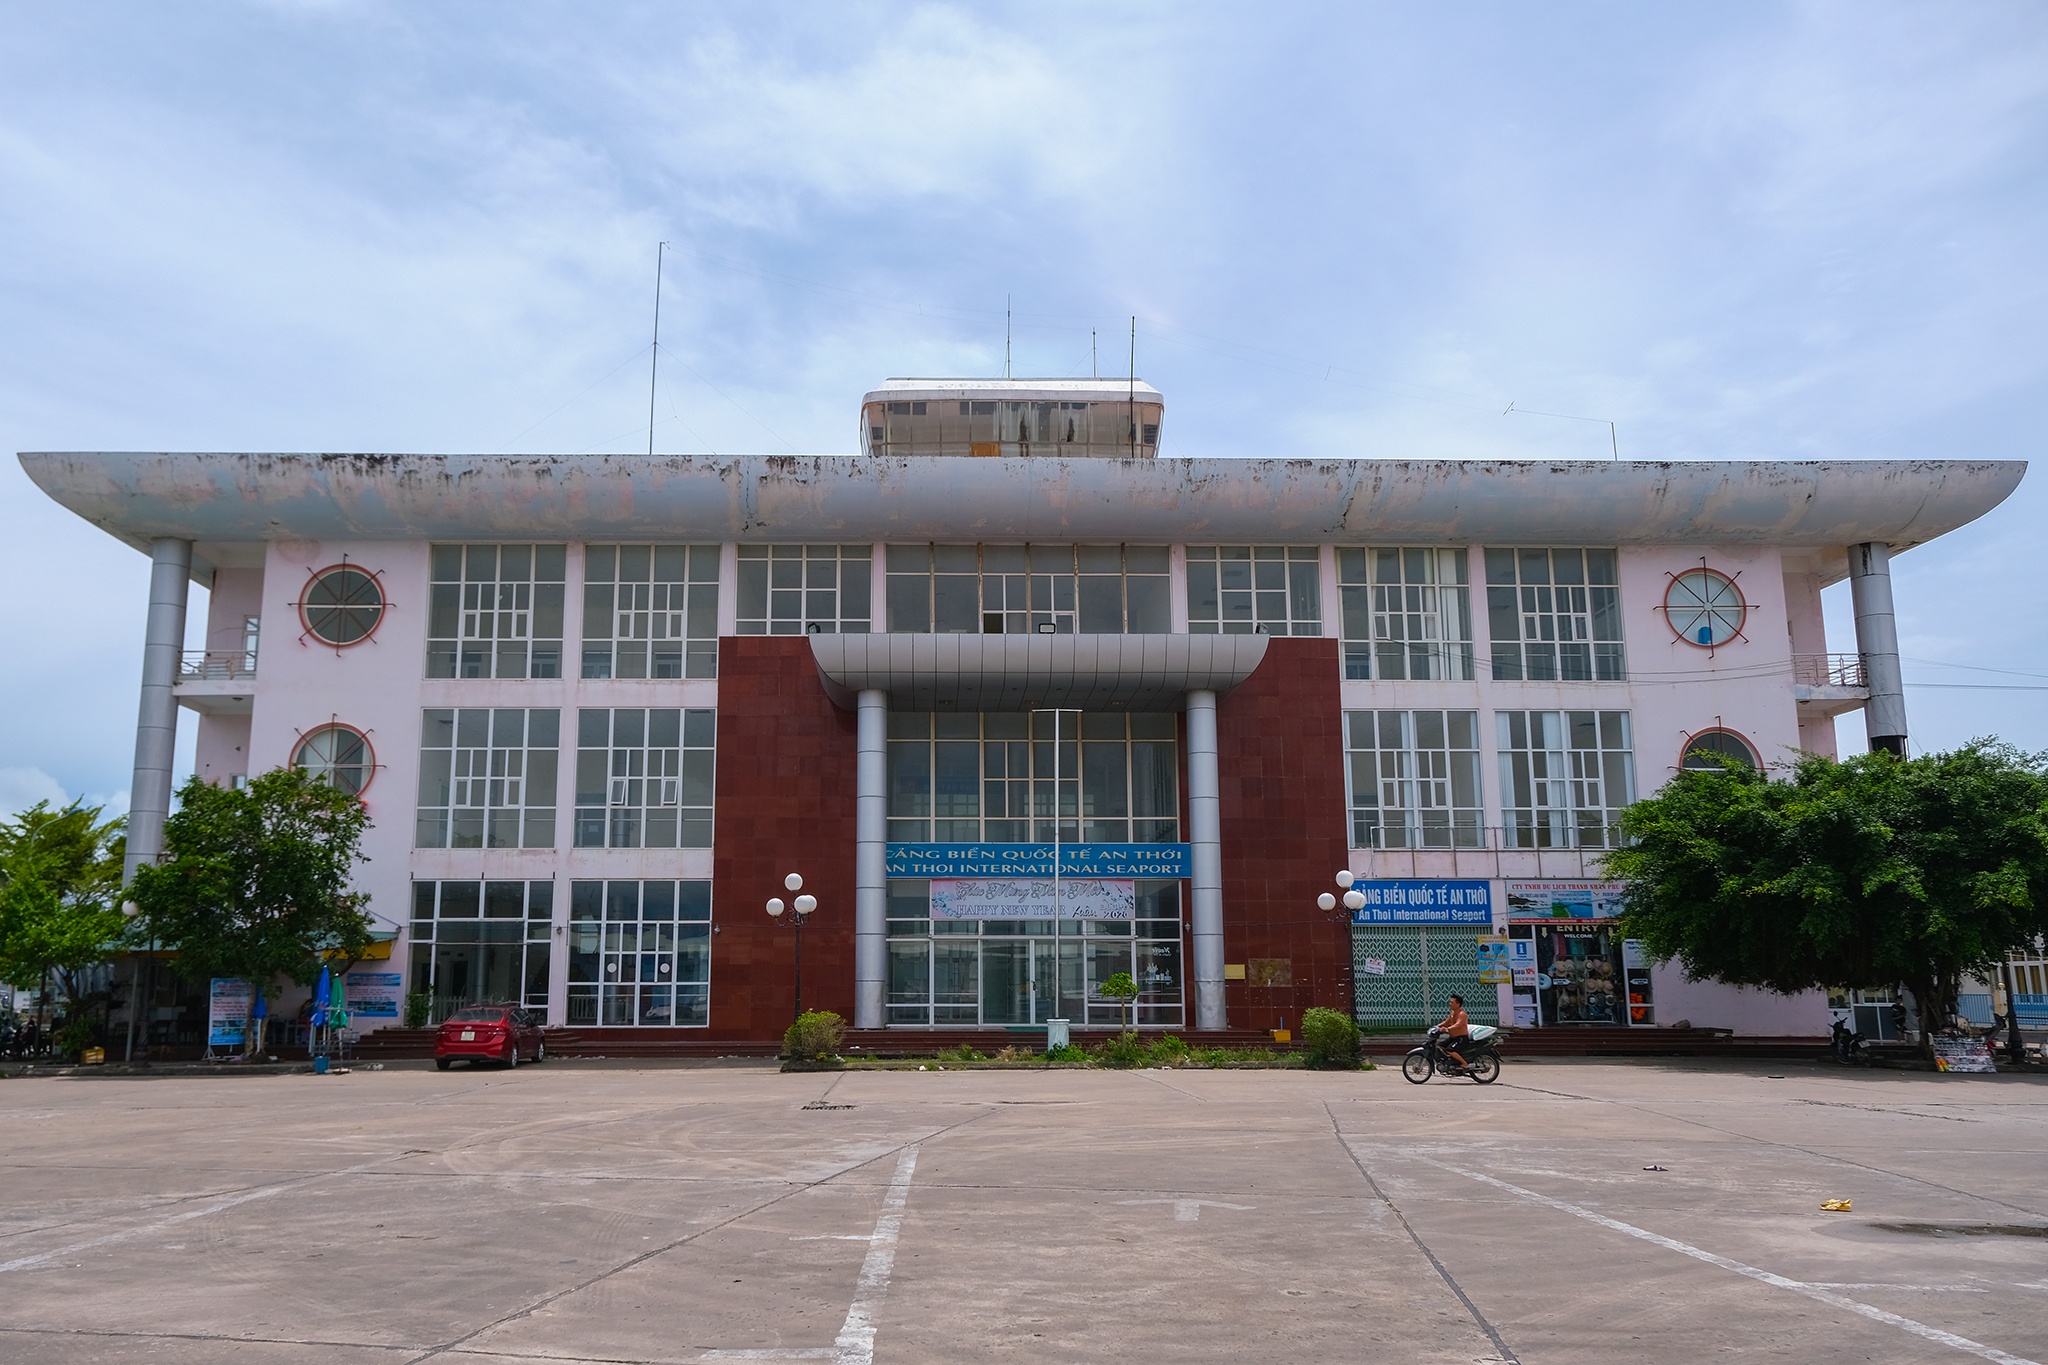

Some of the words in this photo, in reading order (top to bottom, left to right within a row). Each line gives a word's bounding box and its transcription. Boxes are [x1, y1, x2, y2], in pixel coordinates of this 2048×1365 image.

[947, 847, 995, 859] BIỂN
[1002, 847, 1061, 860] QUỐC
[1067, 847, 1092, 860] TẾ
[1098, 851, 1127, 860] AN
[1134, 848, 1182, 860] THỚI
[911, 863, 953, 873] THOI
[960, 863, 1101, 874] INTERNATIONAL
[1107, 864, 1182, 874] SEAPORT
[1355, 883, 1381, 905] ẢNG
[1383, 882, 1406, 905] BIỂN
[1408, 883, 1434, 906] QUỐC
[1436, 883, 1448, 905] TẾ
[1450, 888, 1464, 905] AN
[1465, 885, 1488, 905] THỚI
[956, 904, 999, 916] HAPPY
[1001, 904, 1031, 916] NEW
[1032, 904, 1066, 916] YEAR
[1358, 909, 1370, 920] An
[1372, 909, 1391, 920] Thoi
[1393, 909, 1449, 920] International
[1451, 909, 1486, 922] Seaport
[1556, 924, 1598, 932] ENTRY
